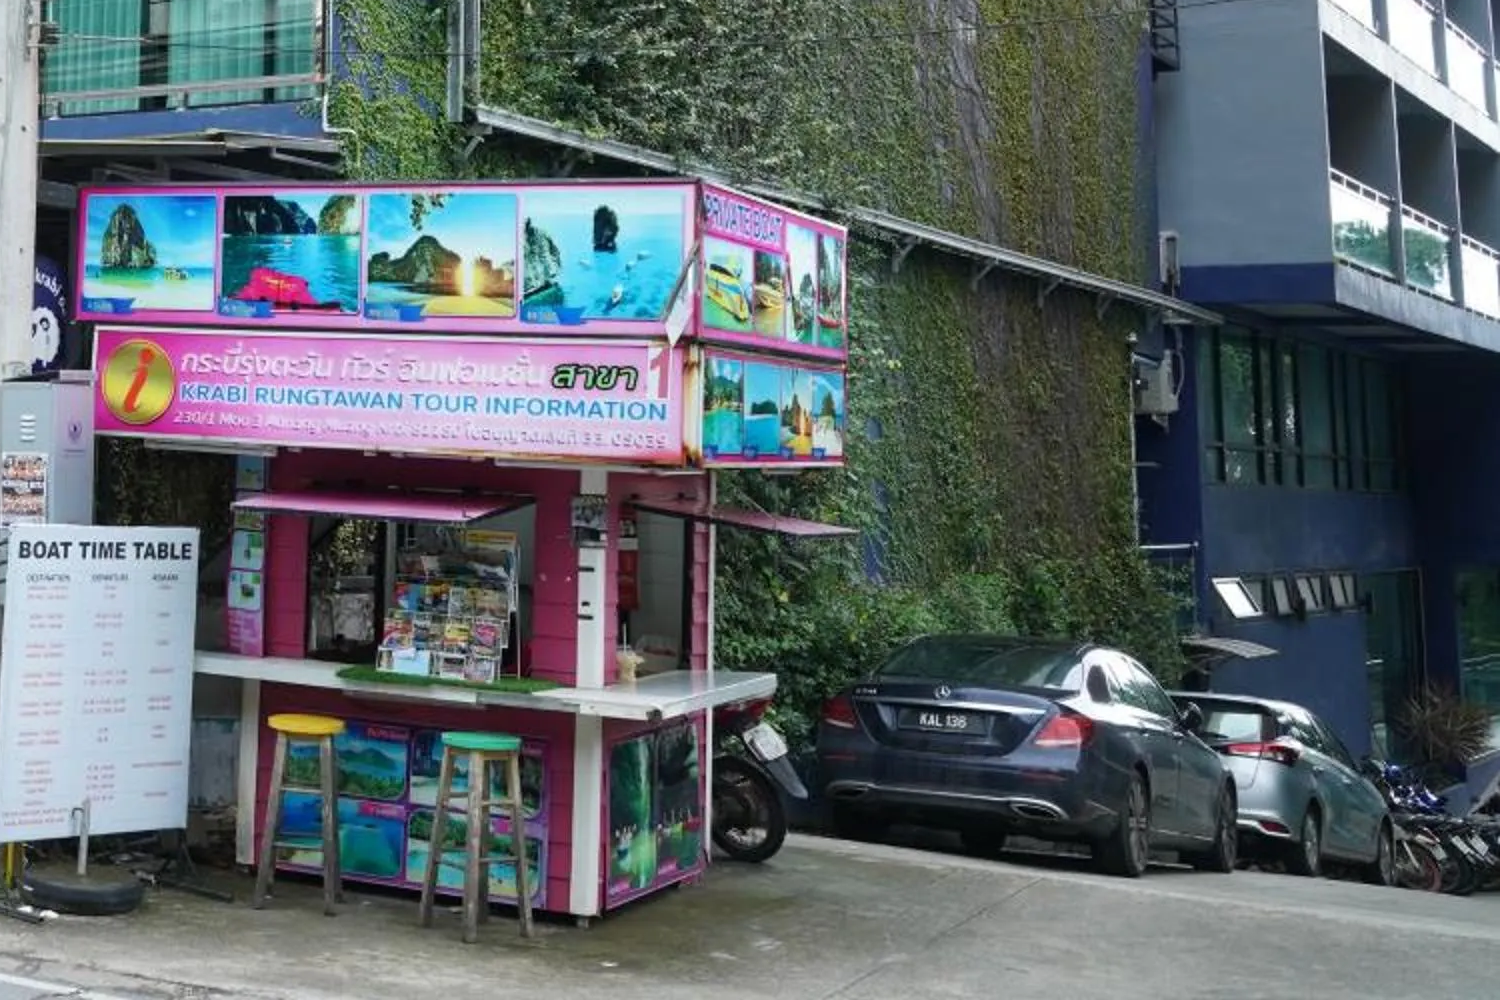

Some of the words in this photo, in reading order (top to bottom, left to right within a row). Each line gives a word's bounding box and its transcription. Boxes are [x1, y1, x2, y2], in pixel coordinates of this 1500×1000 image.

[704, 194, 749, 236] PRIVATE
[750, 207, 781, 243] BOAT
[181, 342, 331, 383] กระบี่รุ่งตะวัน
[340, 348, 389, 383] ทัวร์
[552, 362, 639, 391] สาขา
[647, 345, 670, 400] 1
[181, 383, 248, 404] KRABI
[255, 385, 403, 410] RUNGTAWAN
[411, 393, 478, 414] TOUR
[485, 396, 667, 421] INFORMATION
[19, 541, 72, 559] BOAT
[79, 541, 127, 560] TIME
[133, 541, 193, 561] TABLE
[919, 712, 943, 727] KAL
